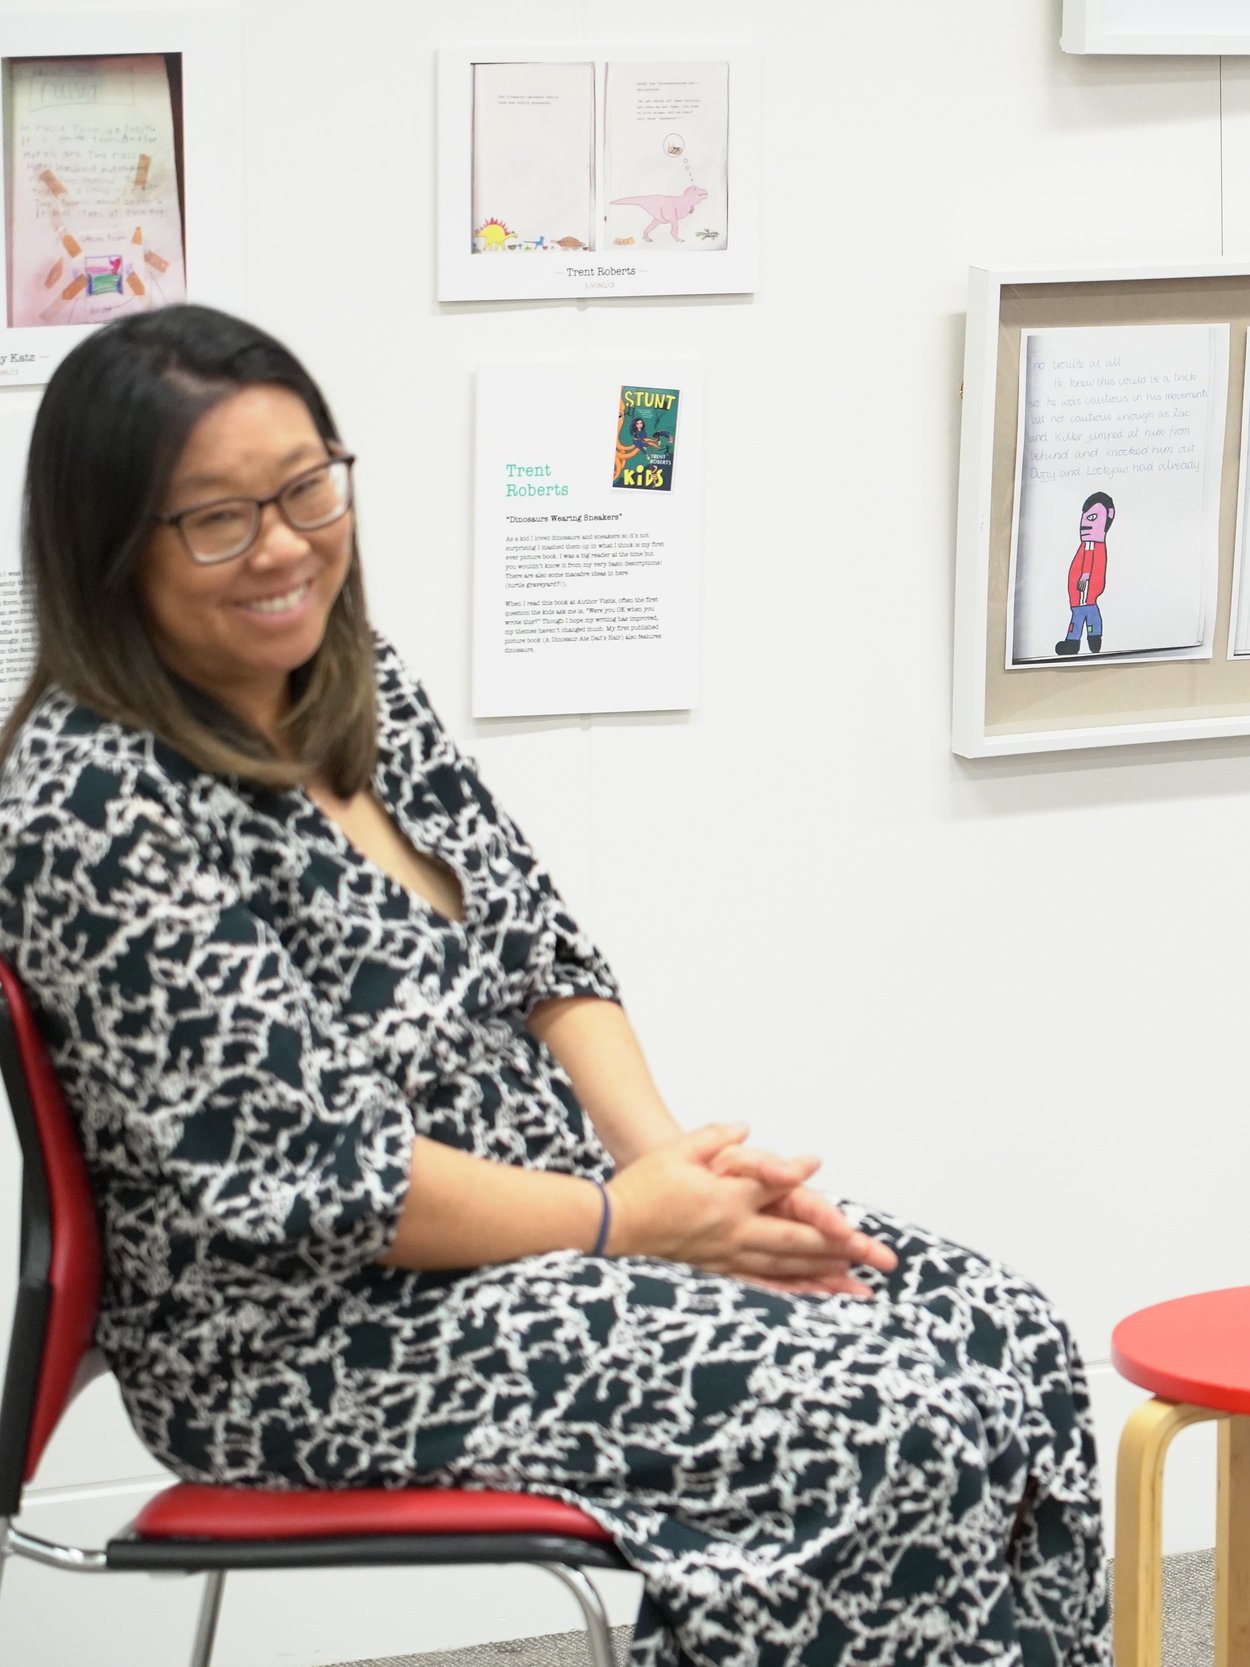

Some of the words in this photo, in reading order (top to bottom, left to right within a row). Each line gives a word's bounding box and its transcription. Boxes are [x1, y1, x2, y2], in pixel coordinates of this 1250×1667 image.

[567, 268, 594, 276] Trent
[597, 267, 636, 276] Roberts
[10, 354, 35, 362] Katz
[1053, 359, 1083, 369] trouble
[1088, 360, 1101, 368] at
[1106, 357, 1121, 367] all
[624, 390, 676, 410] STUNT
[1050, 415, 1064, 424] not
[1070, 413, 1111, 424] cautious
[1117, 411, 1154, 424] enough
[1086, 430, 1123, 445] jumped
[1128, 429, 1139, 440] at
[1145, 427, 1164, 437] him
[1170, 426, 1190, 437] from
[506, 464, 551, 477] Trent
[1060, 467, 1080, 478] and
[1132, 461, 1154, 473] had
[1158, 459, 1200, 474] already
[506, 483, 568, 496] Roberts
[584, 513, 622, 521] Sneakers"
